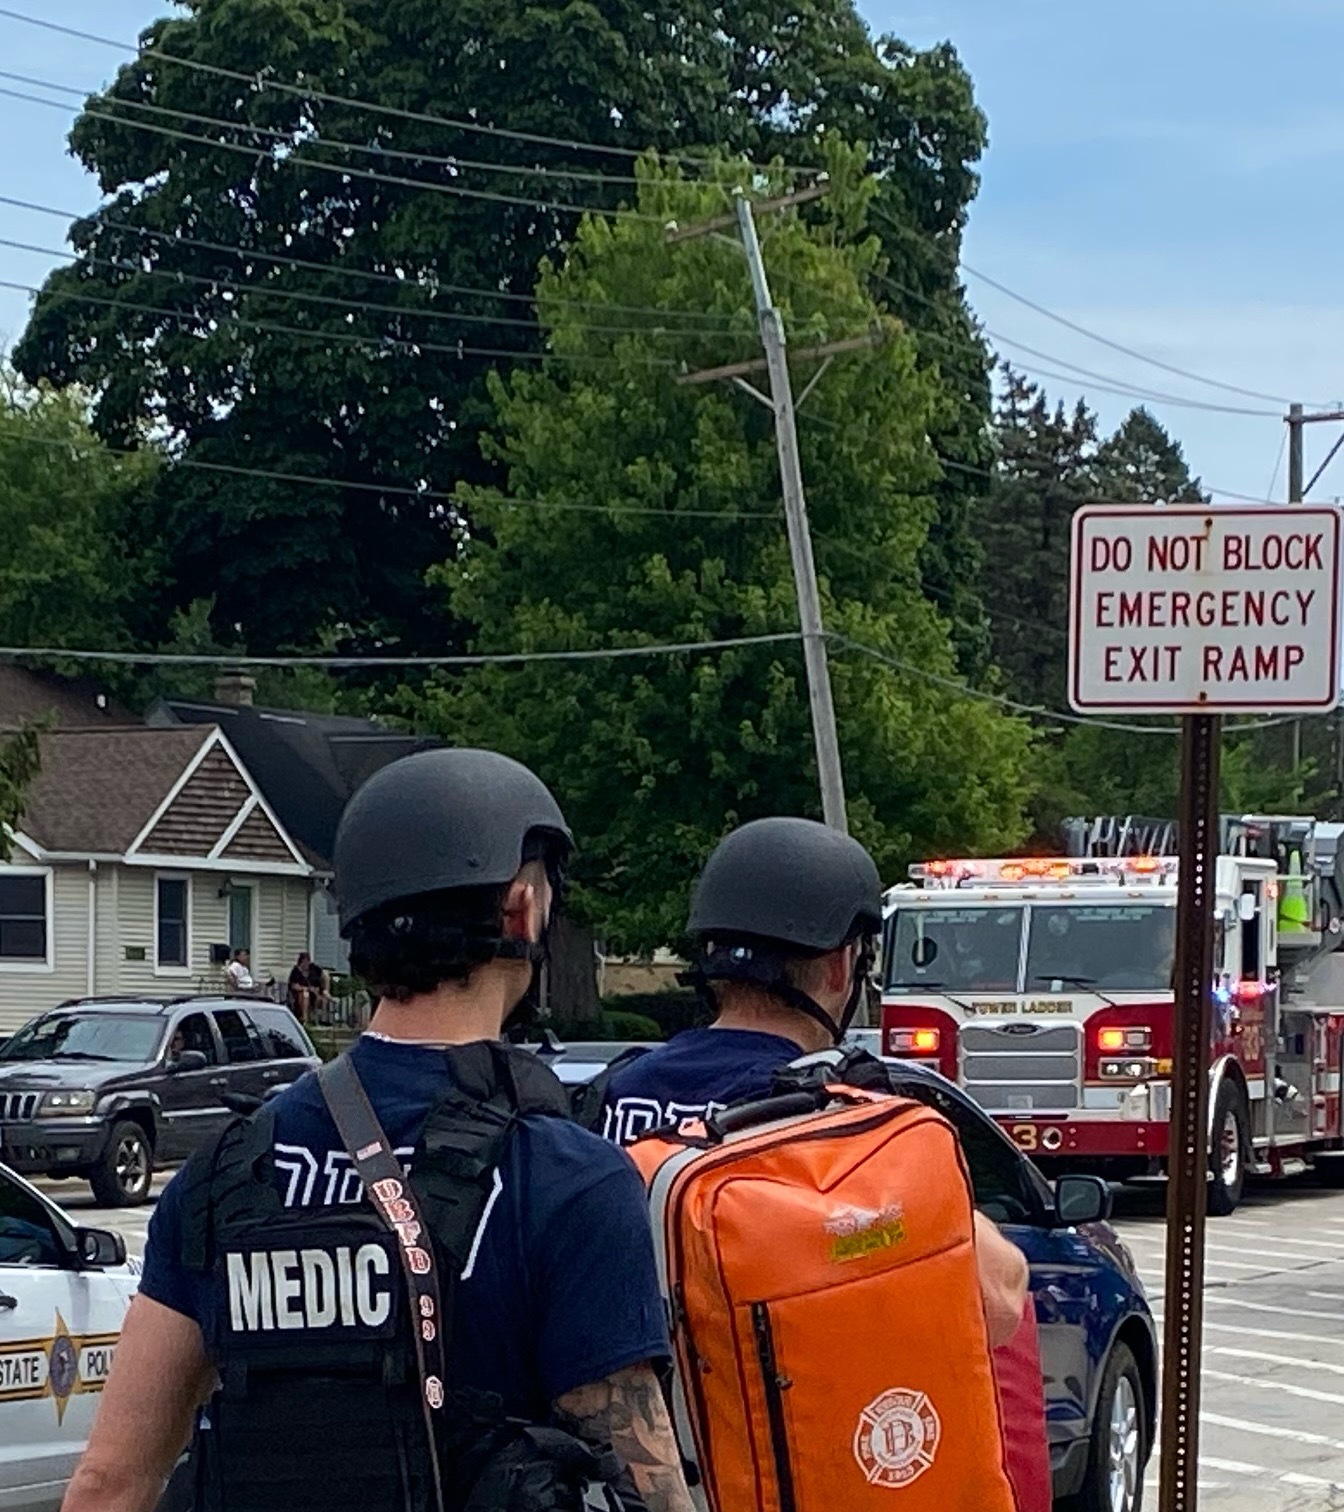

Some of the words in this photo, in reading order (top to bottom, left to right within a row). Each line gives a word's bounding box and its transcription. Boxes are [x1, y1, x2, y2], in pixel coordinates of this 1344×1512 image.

[1091, 536, 1132, 572] DO
[1148, 535, 1208, 572] NOT
[1223, 534, 1324, 571] BLOCK
[1096, 589, 1316, 628] EMERGENCY
[1104, 646, 1182, 682] EXIT
[1202, 645, 1305, 682] RAMP
[1021, 1000, 1073, 1014] LADDER
[225, 1242, 392, 1333] MEDIC
